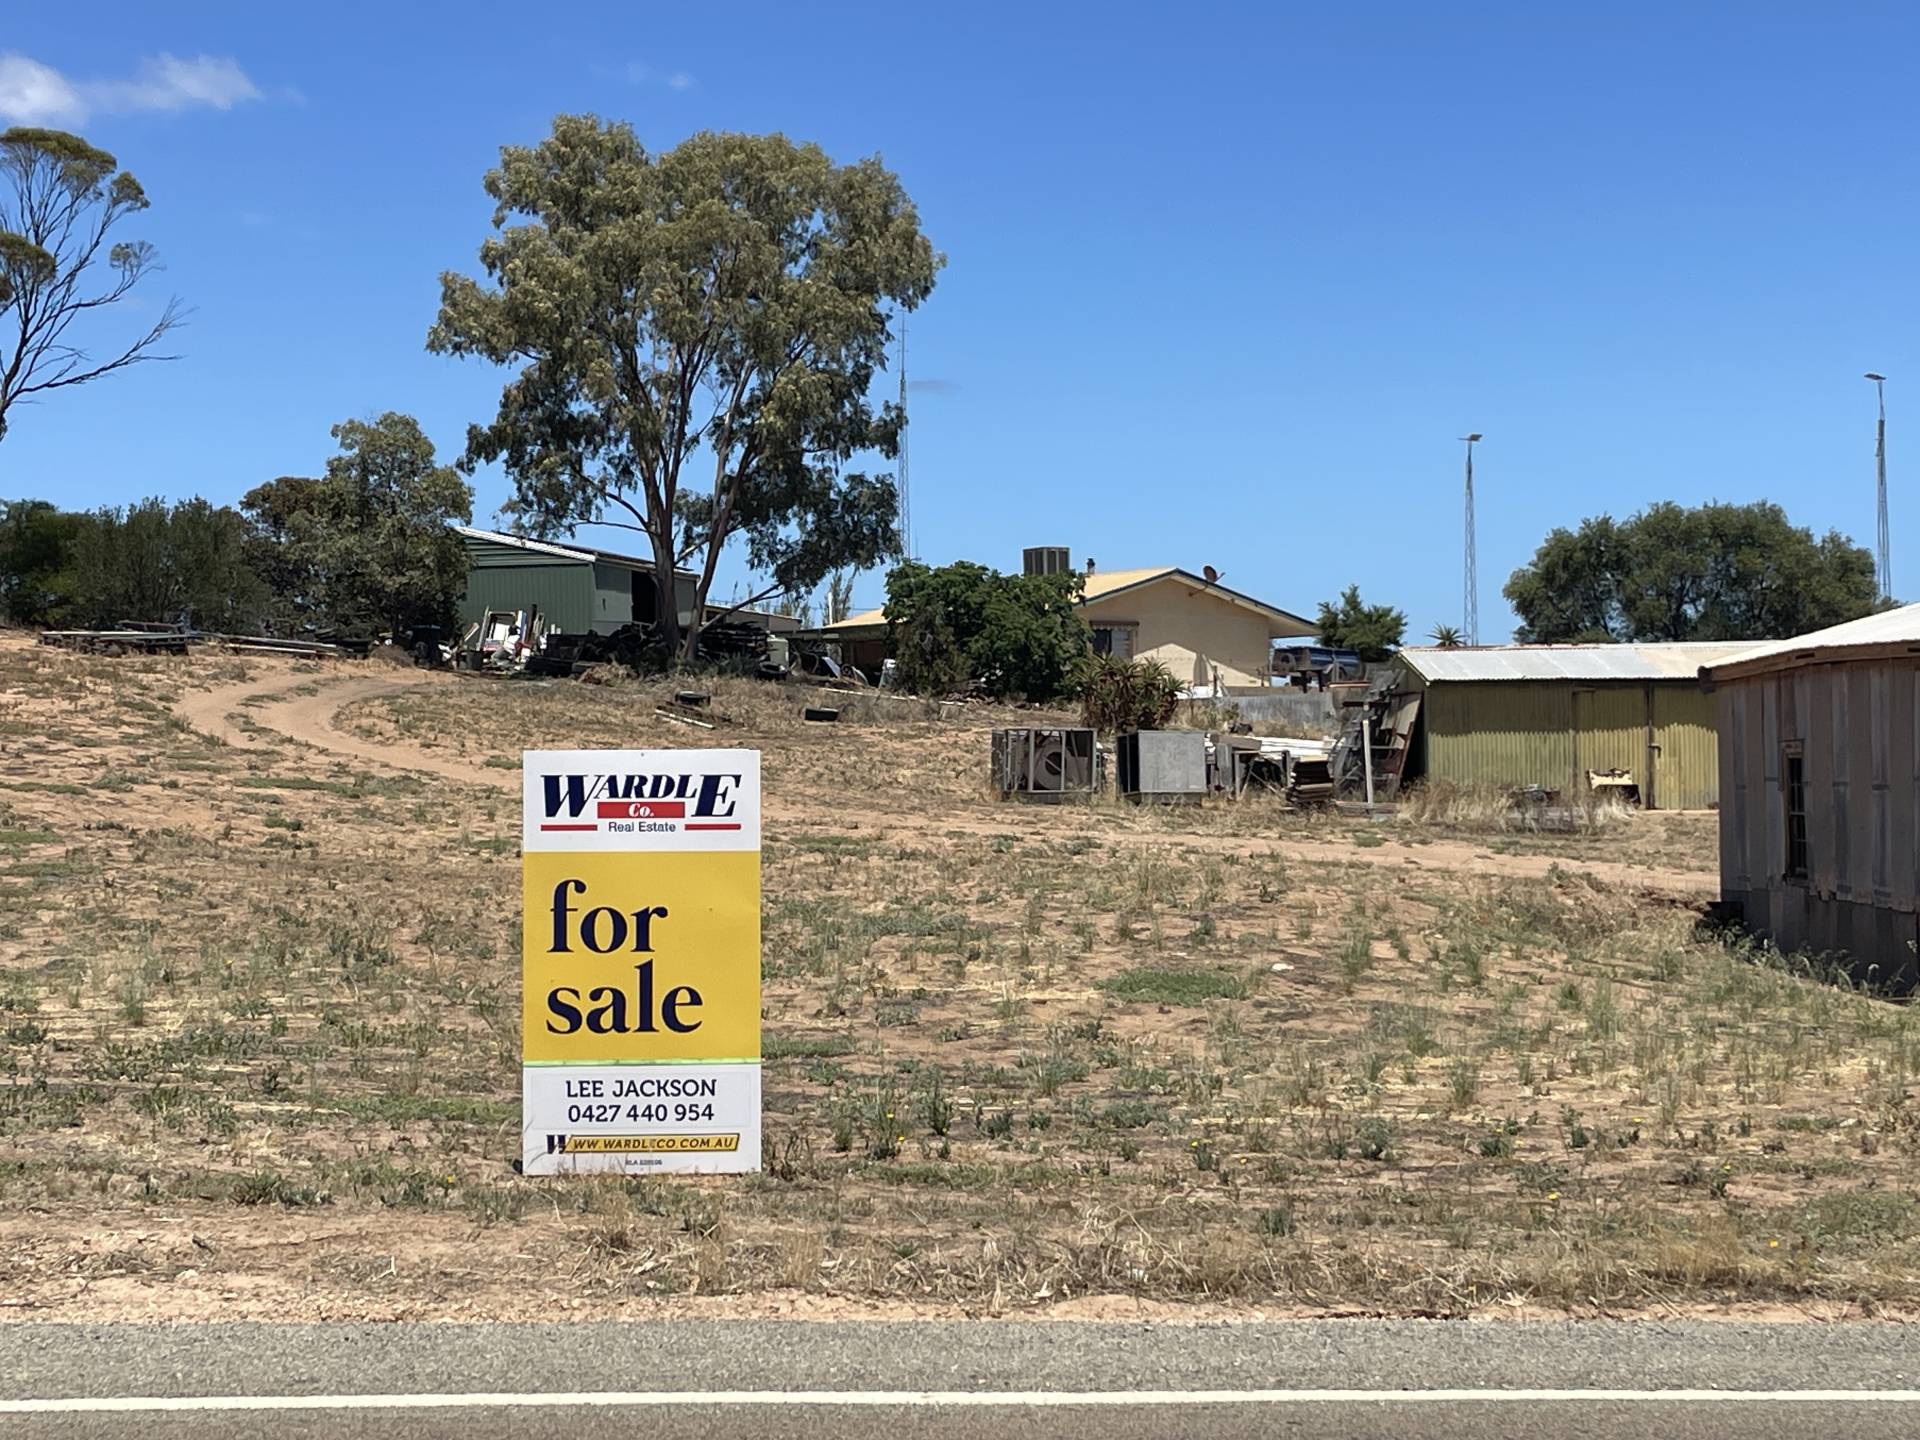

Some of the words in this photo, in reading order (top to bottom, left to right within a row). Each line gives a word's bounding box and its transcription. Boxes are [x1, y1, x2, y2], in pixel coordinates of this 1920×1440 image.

[540, 774, 742, 818] WARDLE
[628, 802, 655, 817] Co.
[608, 821, 635, 832] Real
[638, 821, 676, 832] Estate
[546, 879, 668, 954] for
[546, 958, 703, 1034] sale
[566, 1080, 604, 1098] LEE
[612, 1079, 717, 1098] JACKSON
[568, 1104, 622, 1123] 0427
[626, 1103, 668, 1122] 440
[674, 1103, 715, 1121] 954
